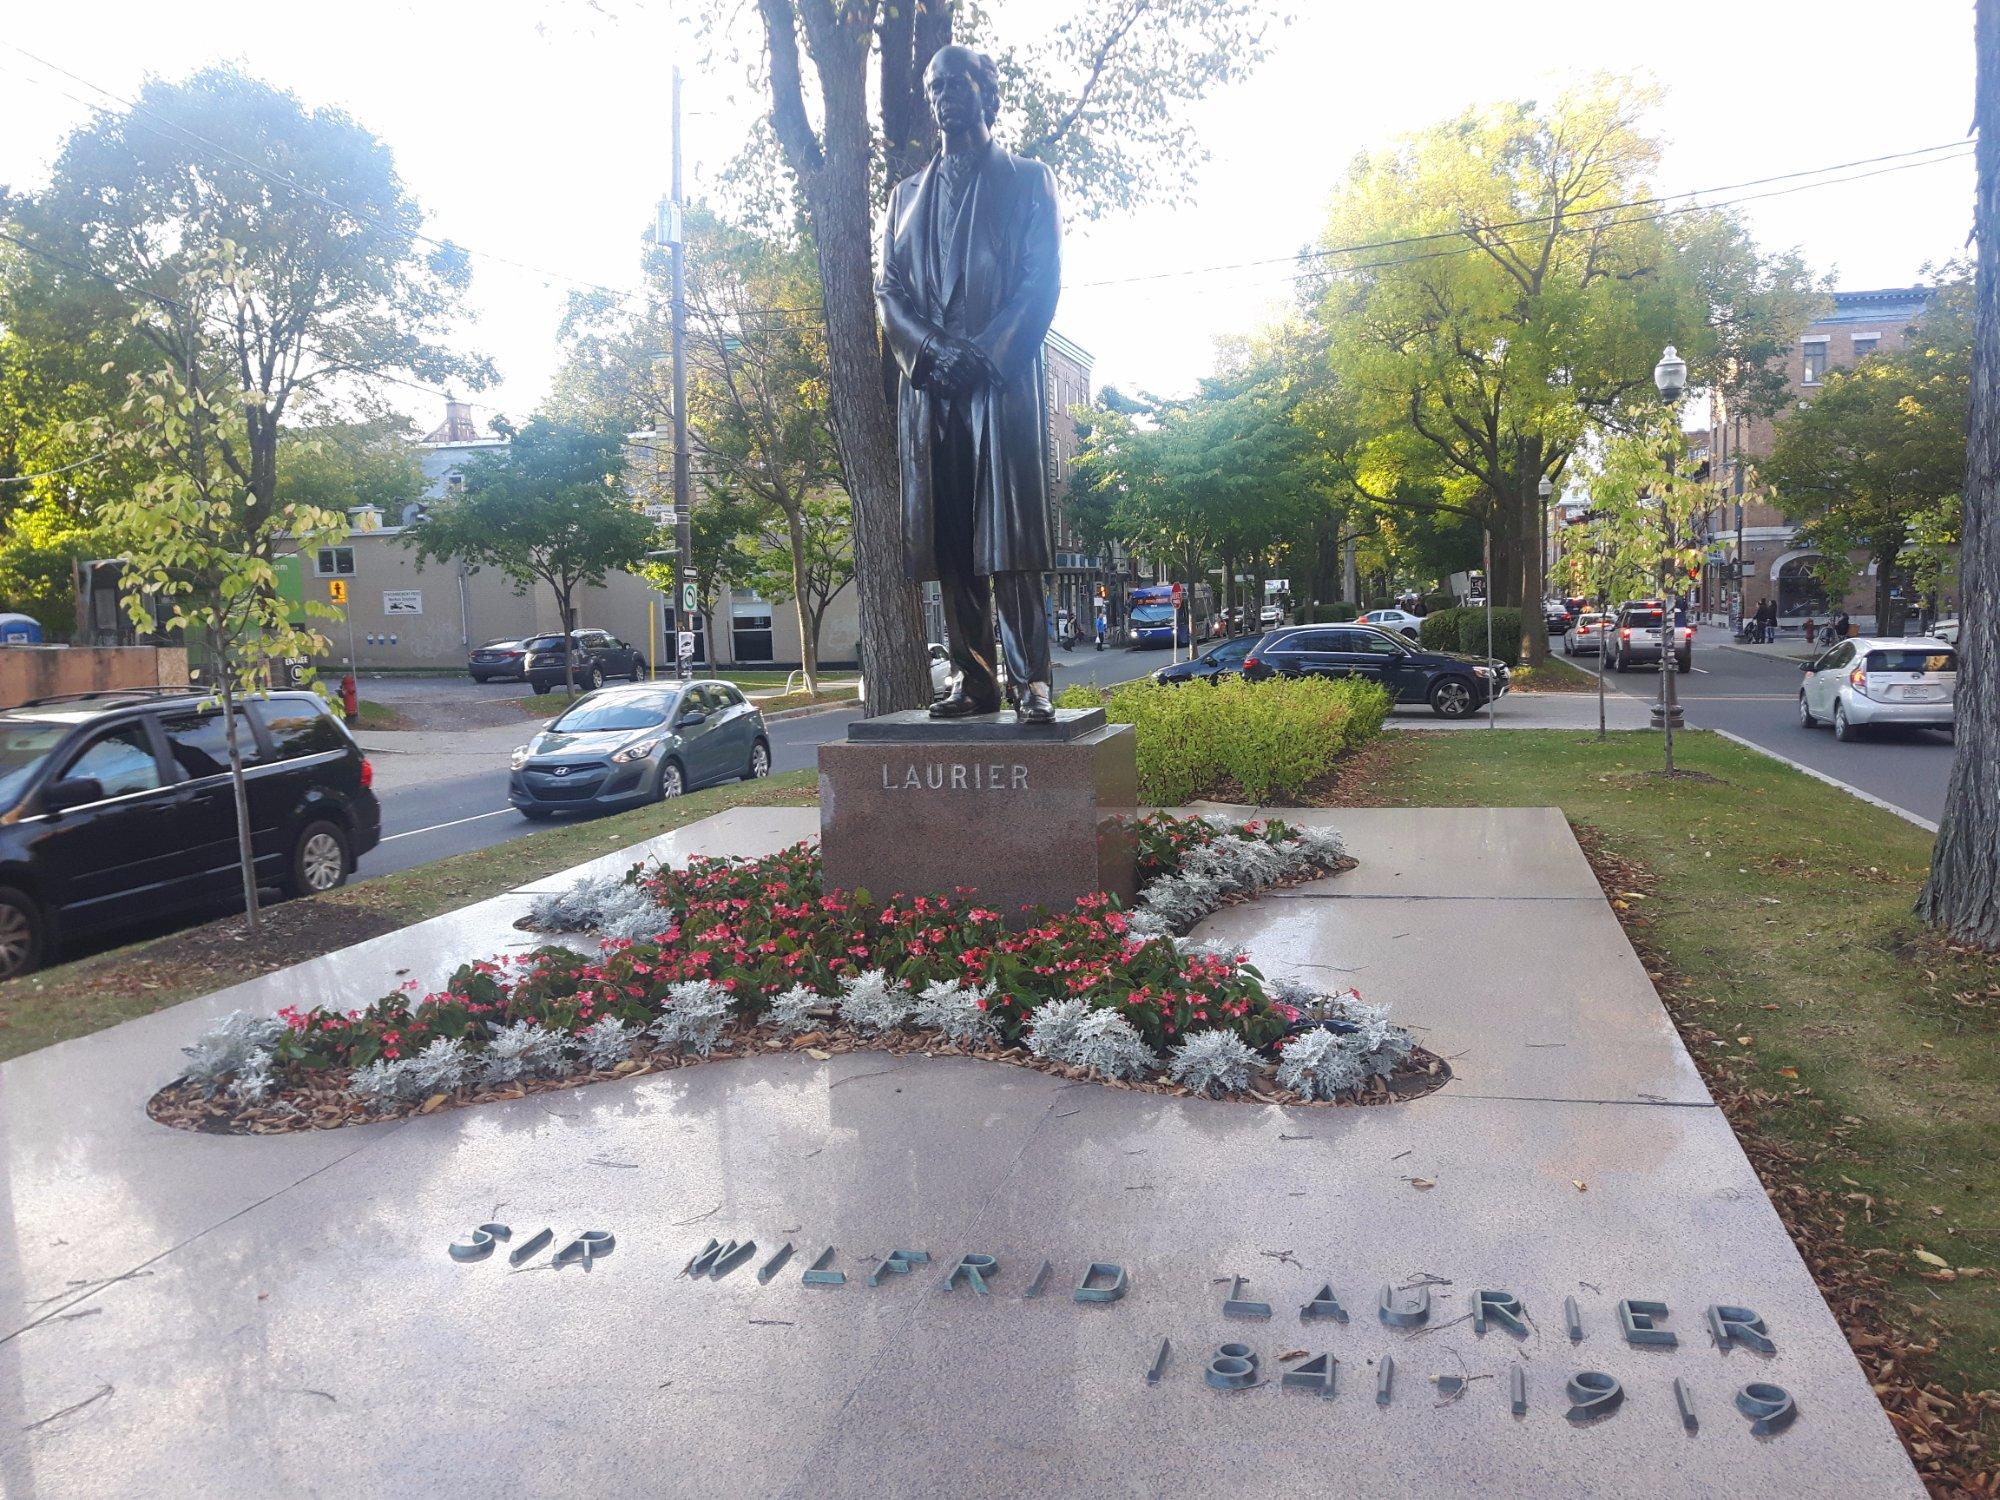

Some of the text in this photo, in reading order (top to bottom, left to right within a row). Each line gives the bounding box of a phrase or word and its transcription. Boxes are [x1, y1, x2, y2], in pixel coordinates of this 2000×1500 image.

[882, 763, 1029, 789] LAURIER
[448, 1222, 1776, 1354] SIR WILFRID LAURIER
